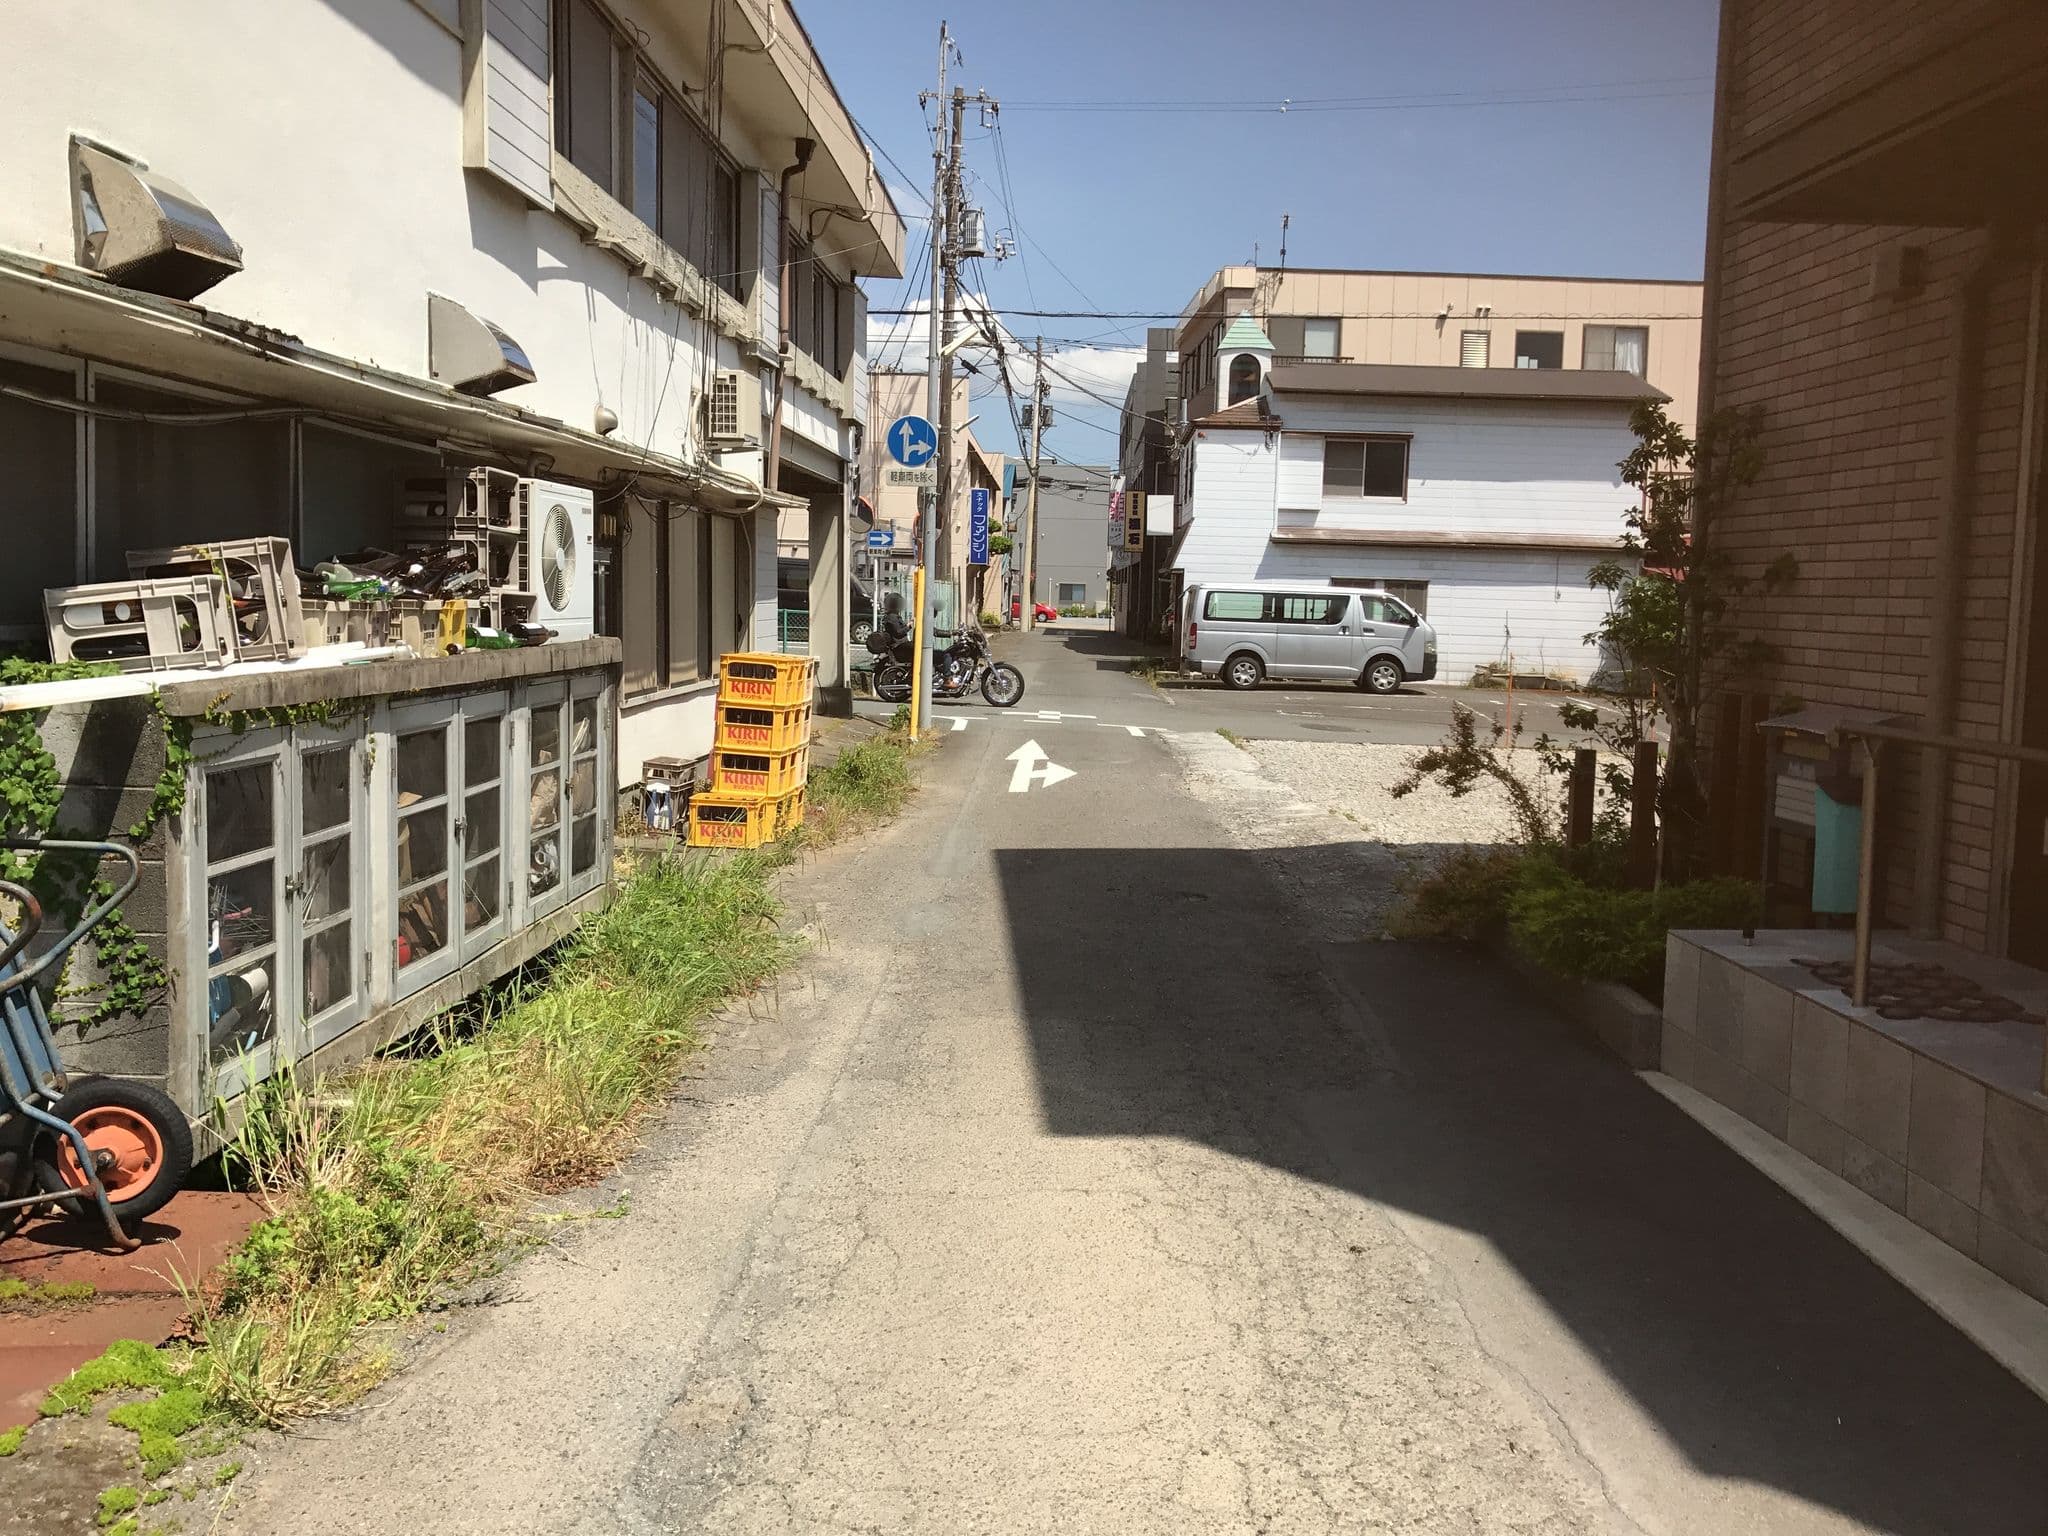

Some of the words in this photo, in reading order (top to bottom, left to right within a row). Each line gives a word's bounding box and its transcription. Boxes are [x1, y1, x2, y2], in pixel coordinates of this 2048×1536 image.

[890, 471, 933, 483] 軽車両を除く
[975, 492, 984, 513] スナック
[731, 681, 772, 695] KIRIN
[728, 726, 769, 741] KIRIN
[724, 771, 765, 786] KIRIN
[700, 823, 743, 838] KIRIN
